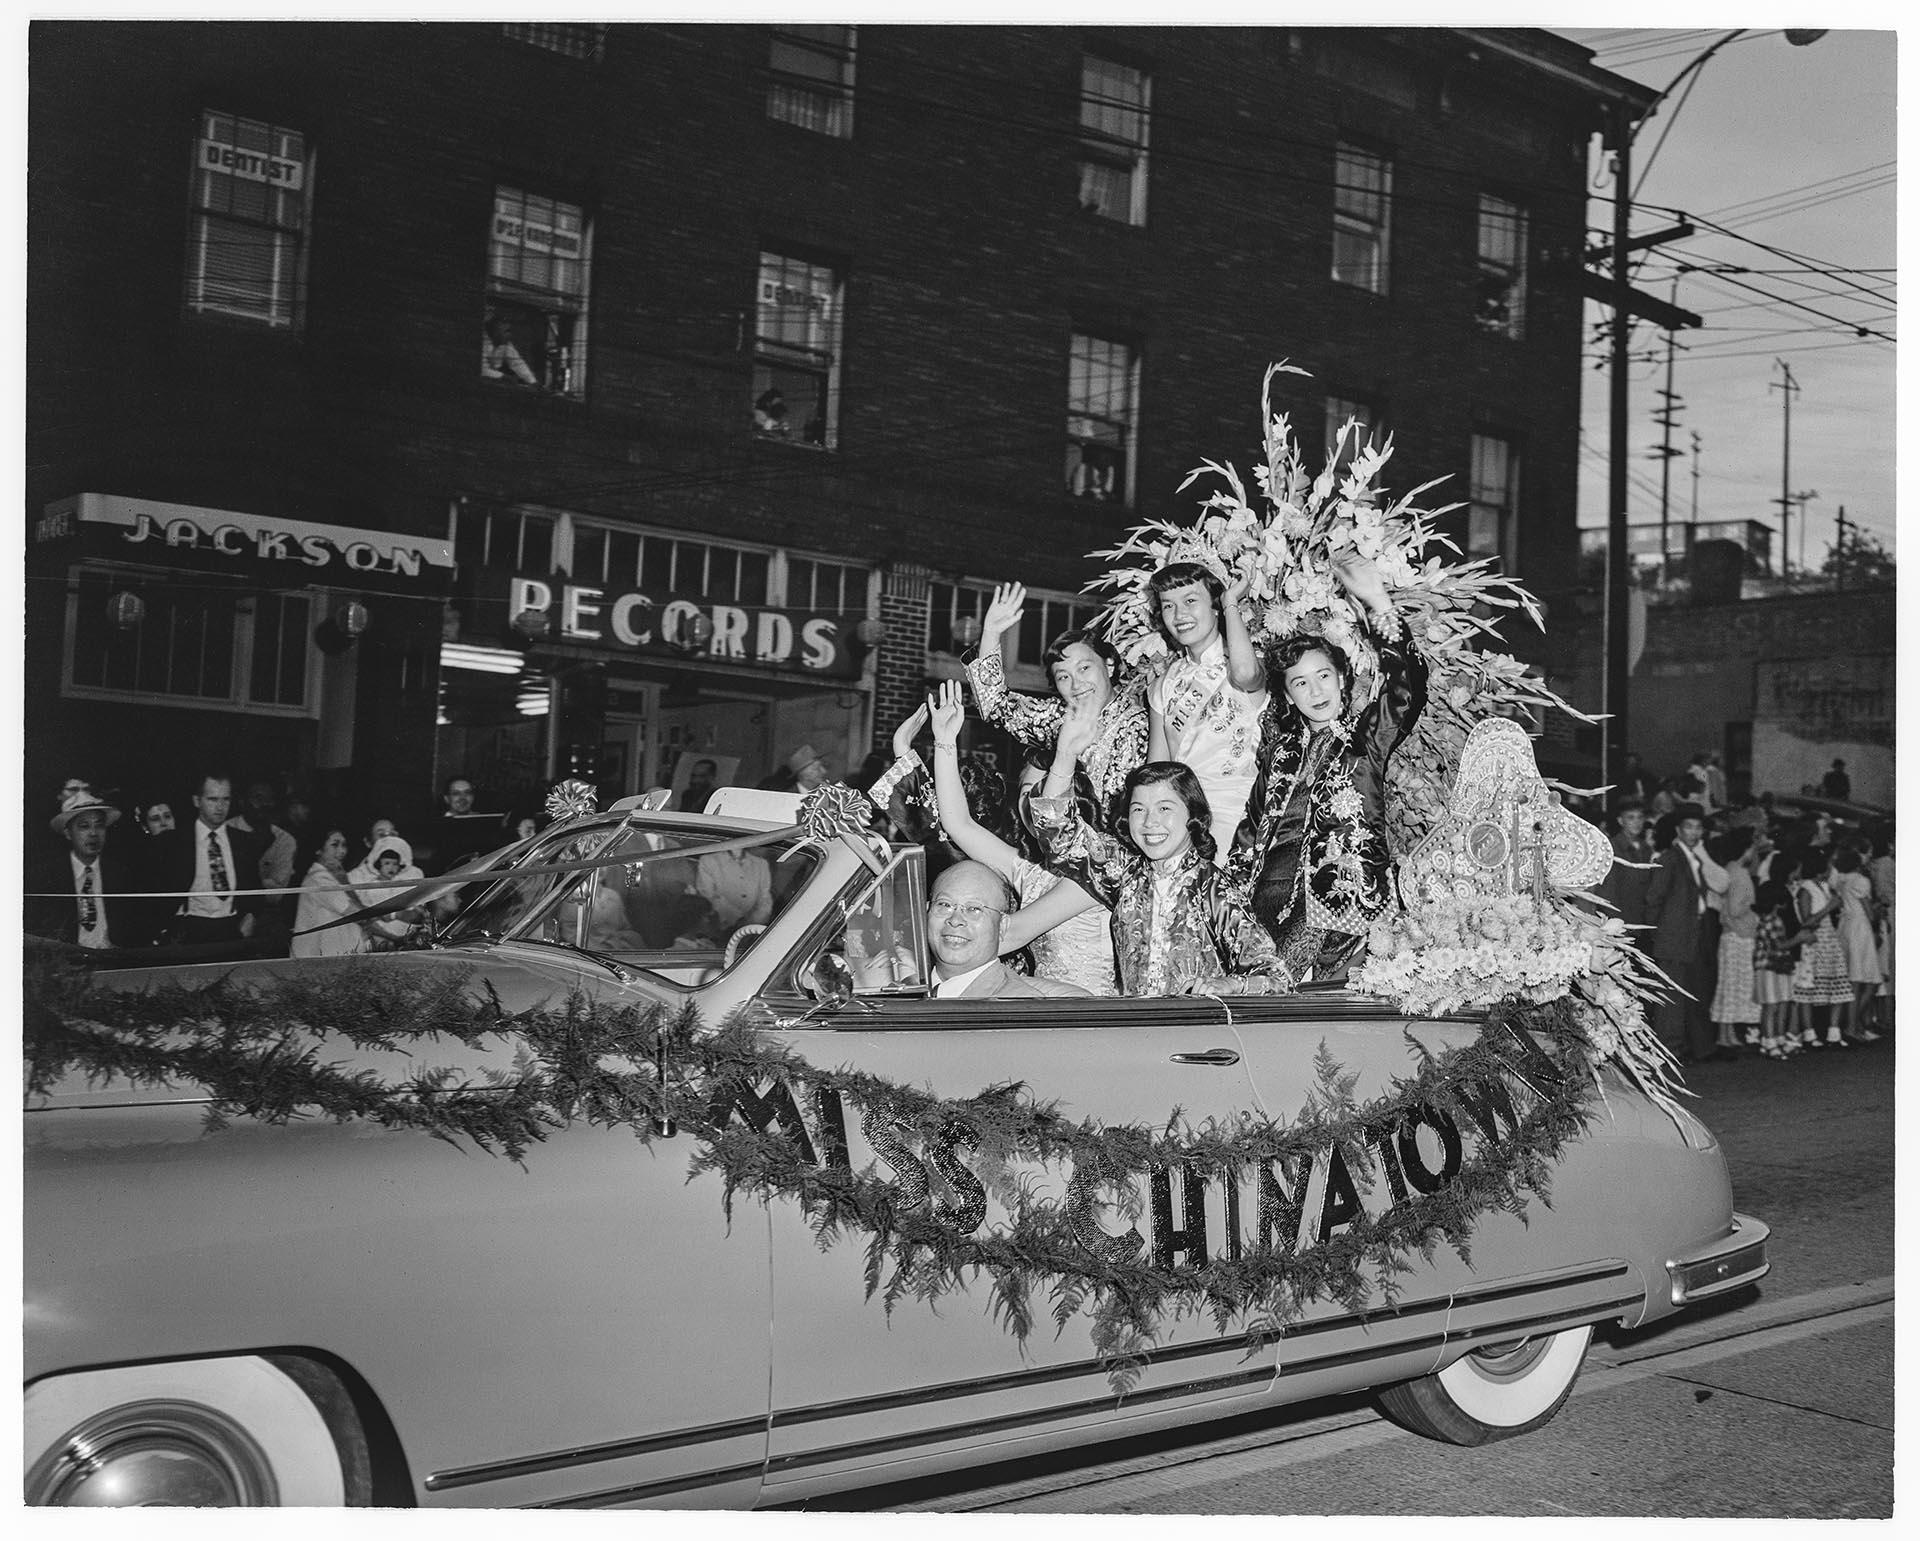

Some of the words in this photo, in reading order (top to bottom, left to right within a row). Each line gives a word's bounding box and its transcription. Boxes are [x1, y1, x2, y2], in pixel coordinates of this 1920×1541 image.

[207, 146, 295, 182] DENTIST
[121, 513, 422, 577] JACKSON
[509, 577, 838, 670] RECORDS
[1171, 689, 1203, 732] MISS
[706, 1077, 986, 1235] MISS
[1065, 1022, 1564, 1269] CHINATOWN
